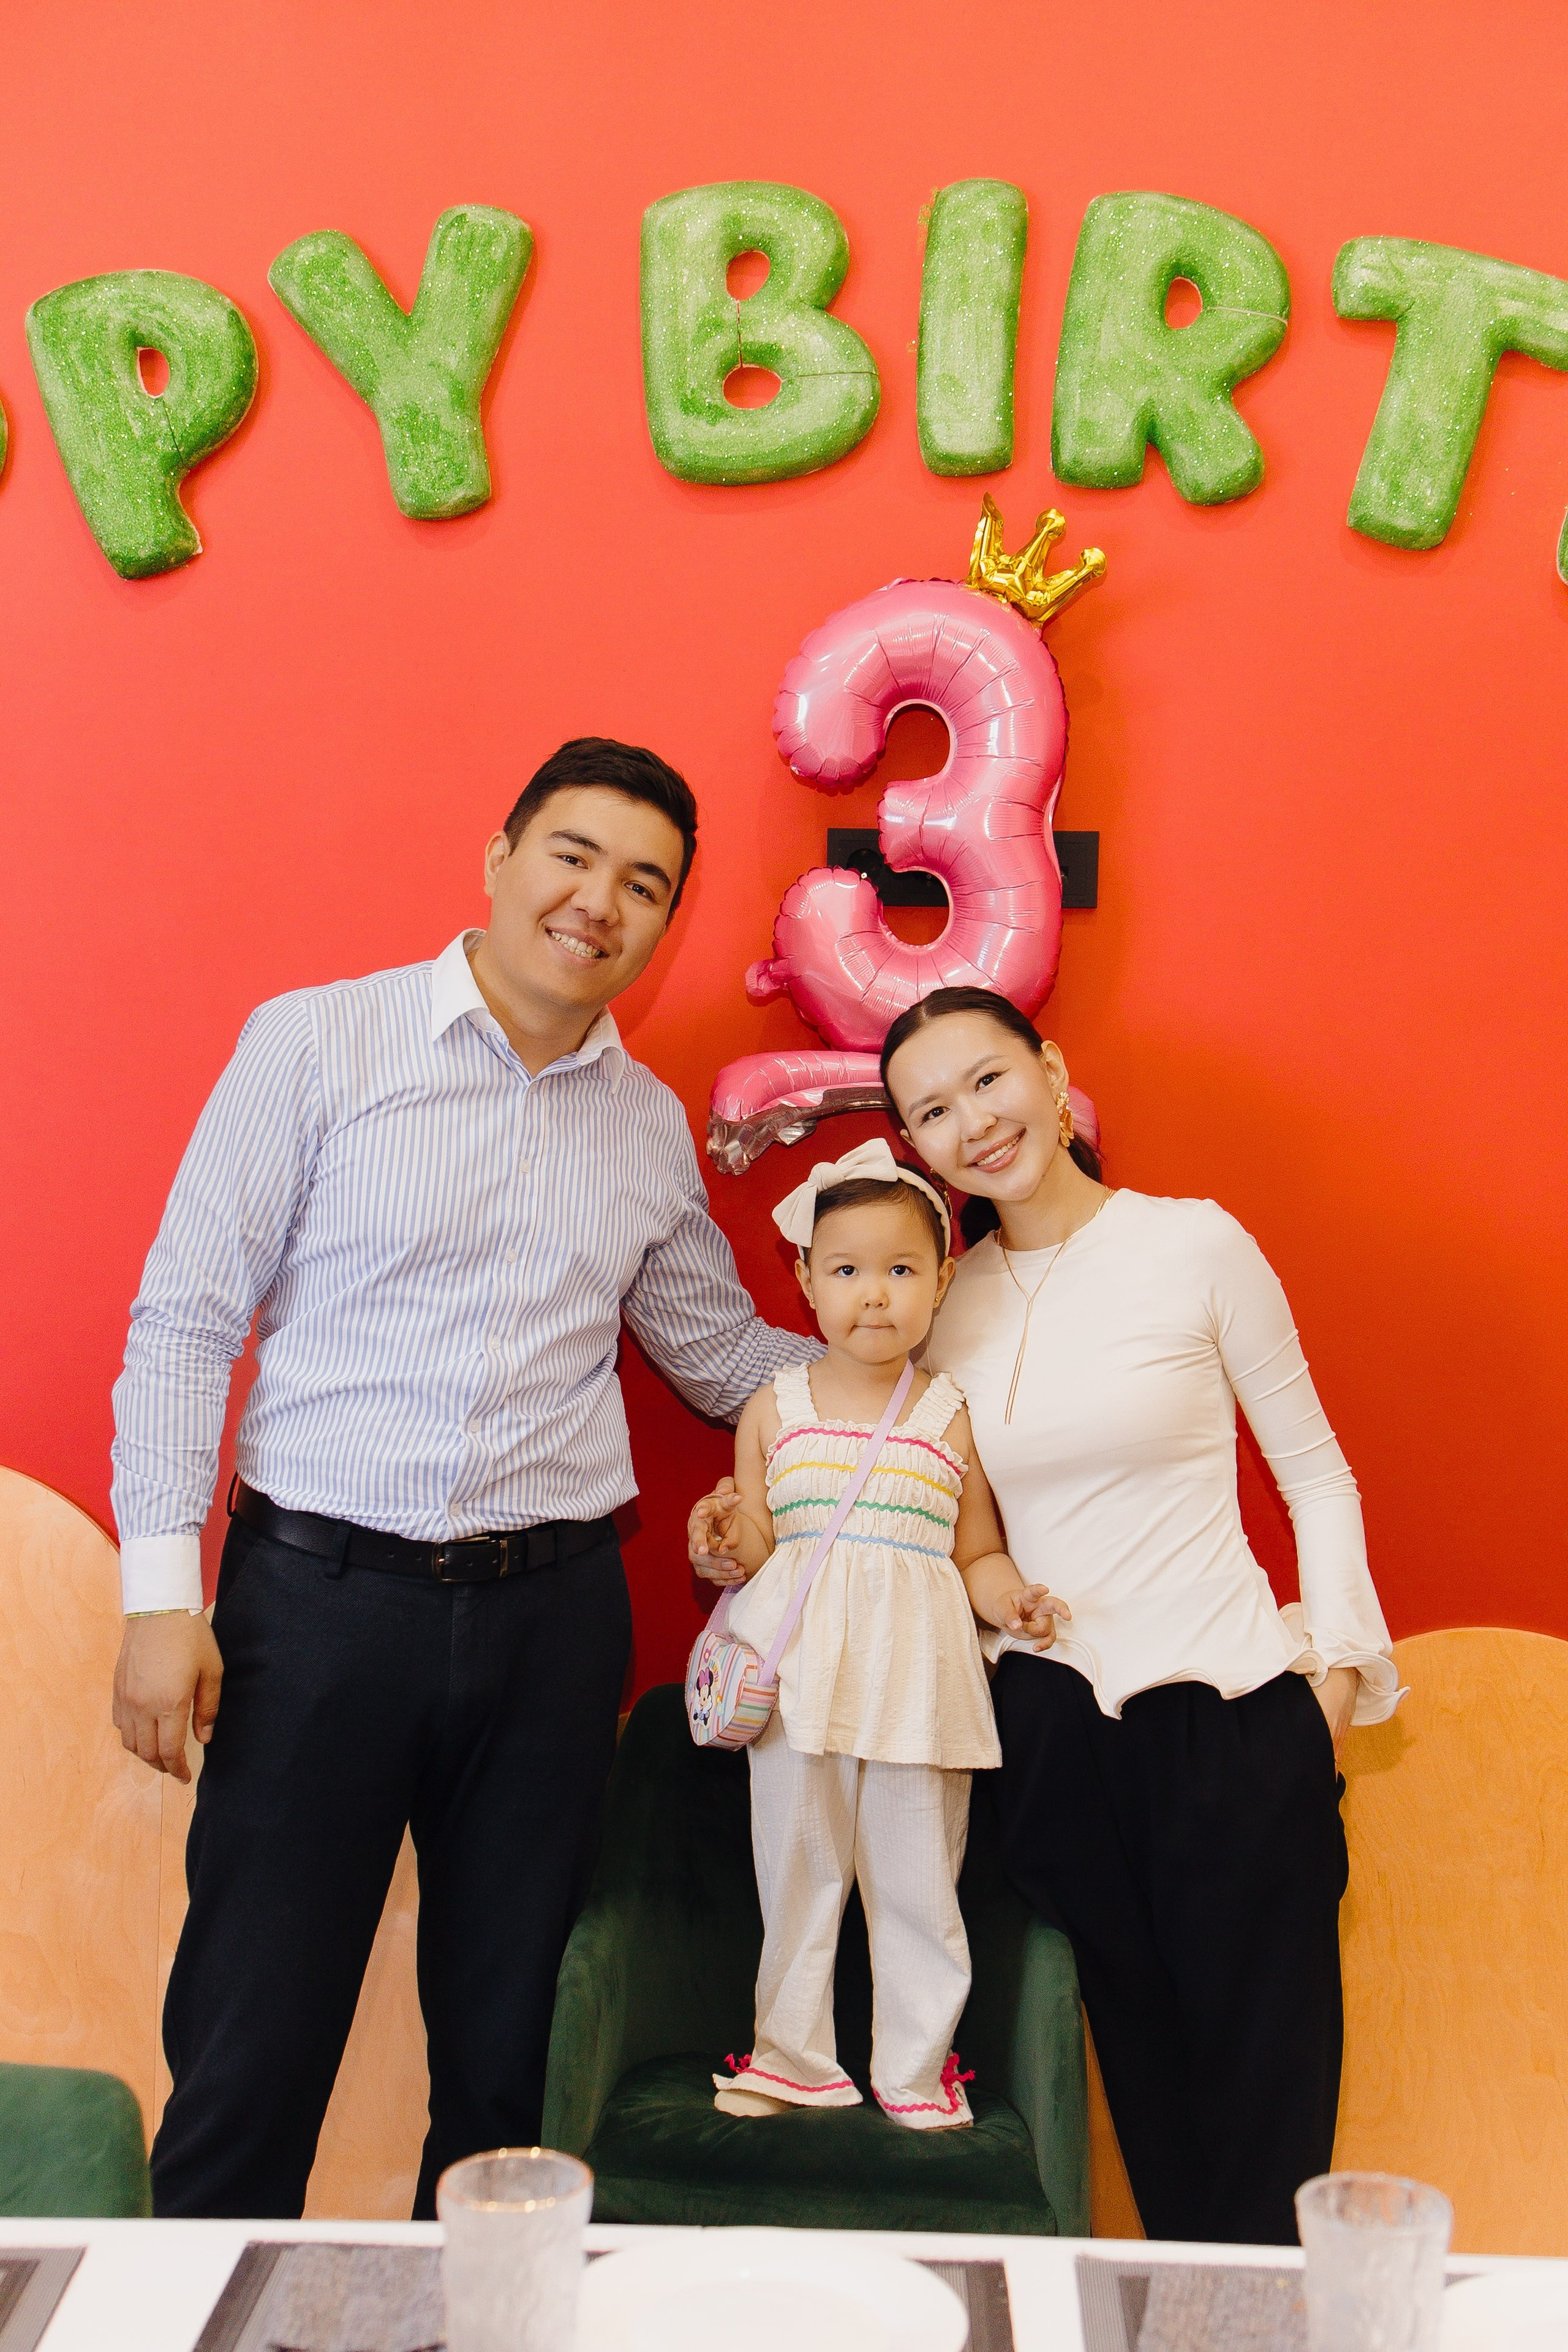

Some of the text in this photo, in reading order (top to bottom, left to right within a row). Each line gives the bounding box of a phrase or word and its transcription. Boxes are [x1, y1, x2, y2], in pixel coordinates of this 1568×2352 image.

[0, 179, 1568, 586] PY BIRT
[772, 578, 1068, 1051] 3
